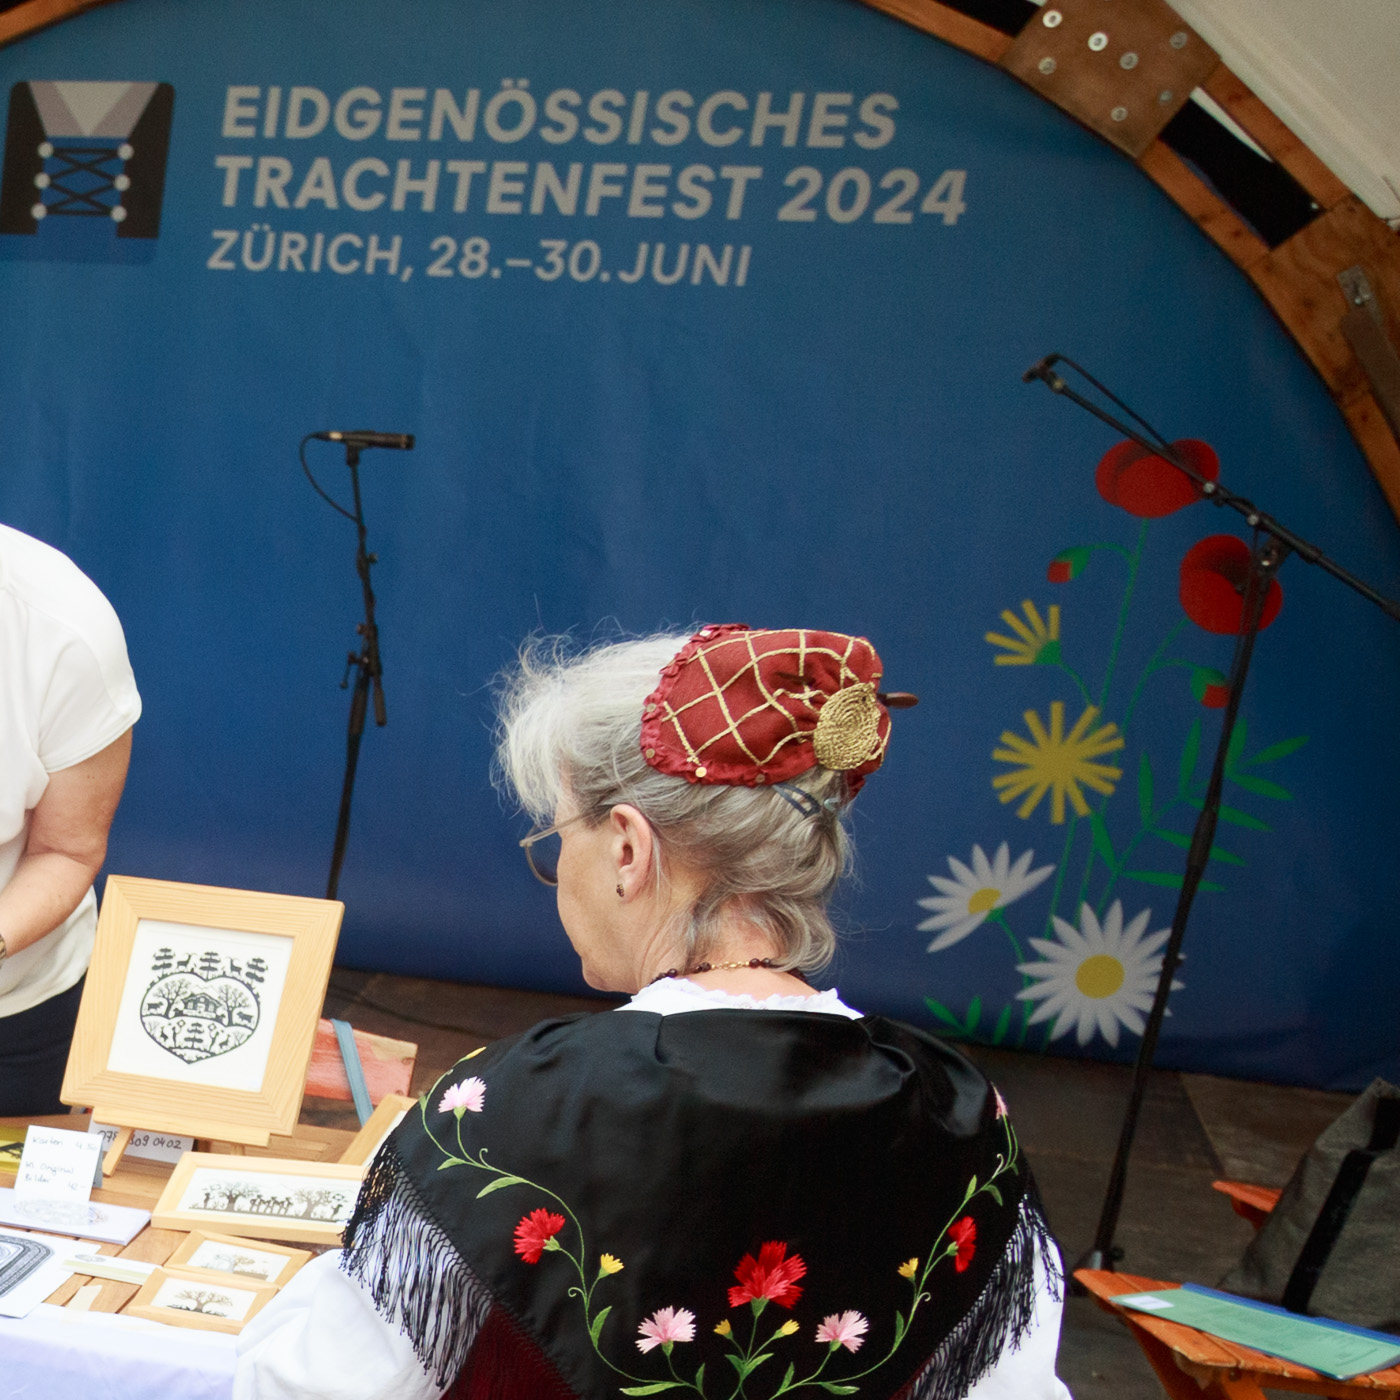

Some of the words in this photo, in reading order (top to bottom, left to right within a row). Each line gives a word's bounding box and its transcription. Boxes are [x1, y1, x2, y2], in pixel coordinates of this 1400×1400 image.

[221, 78, 899, 150] EIDGENÖSSISCHES
[214, 155, 763, 221] TRACHTENFEST
[776, 165, 967, 227] 2024
[206, 222, 414, 283] ZÜRICH,
[617, 241, 752, 288] JUNI
